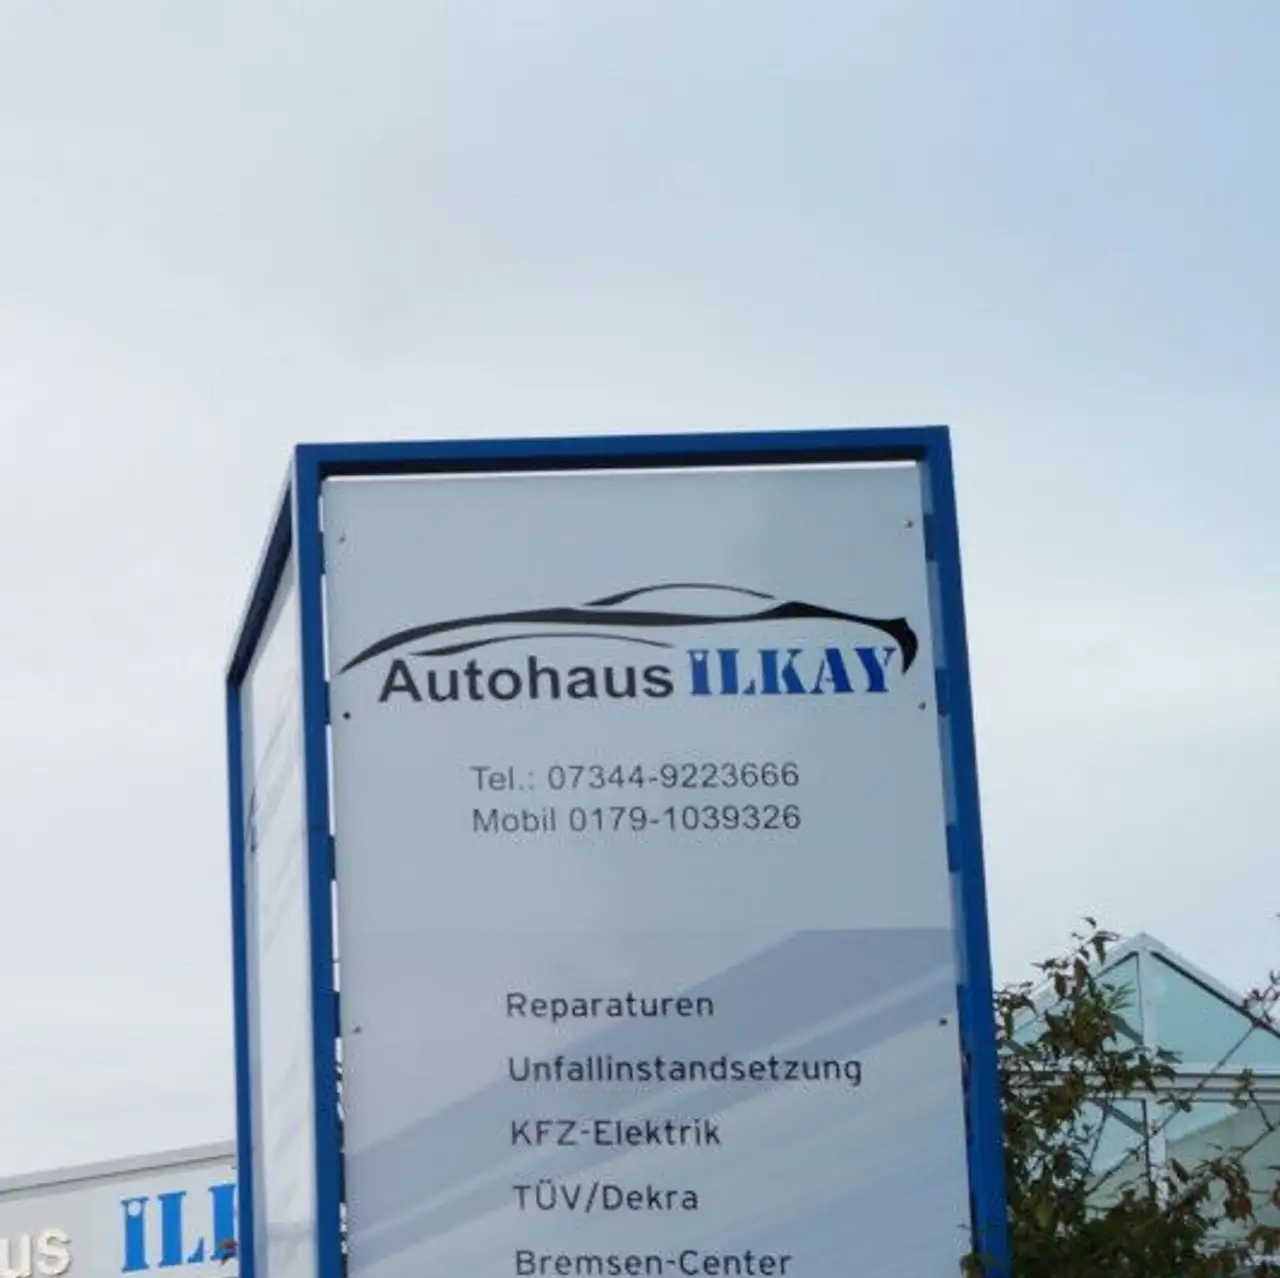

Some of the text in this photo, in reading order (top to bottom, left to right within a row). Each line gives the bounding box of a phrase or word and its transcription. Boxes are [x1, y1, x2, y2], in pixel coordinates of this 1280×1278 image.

[377, 646, 897, 702] Autohaus ILKAY
[470, 762, 800, 792] Tel.: 07344-9223666
[472, 804, 802, 834] Mobil 0179-1039326
[506, 992, 715, 1024] Reparaturen
[507, 1053, 864, 1087] Unfallinstandsetzung
[510, 1118, 722, 1148] KFZ-Elektrik
[512, 1177, 700, 1213] TÜV/Dekra
[514, 1249, 794, 1278] Bremsen-Center
